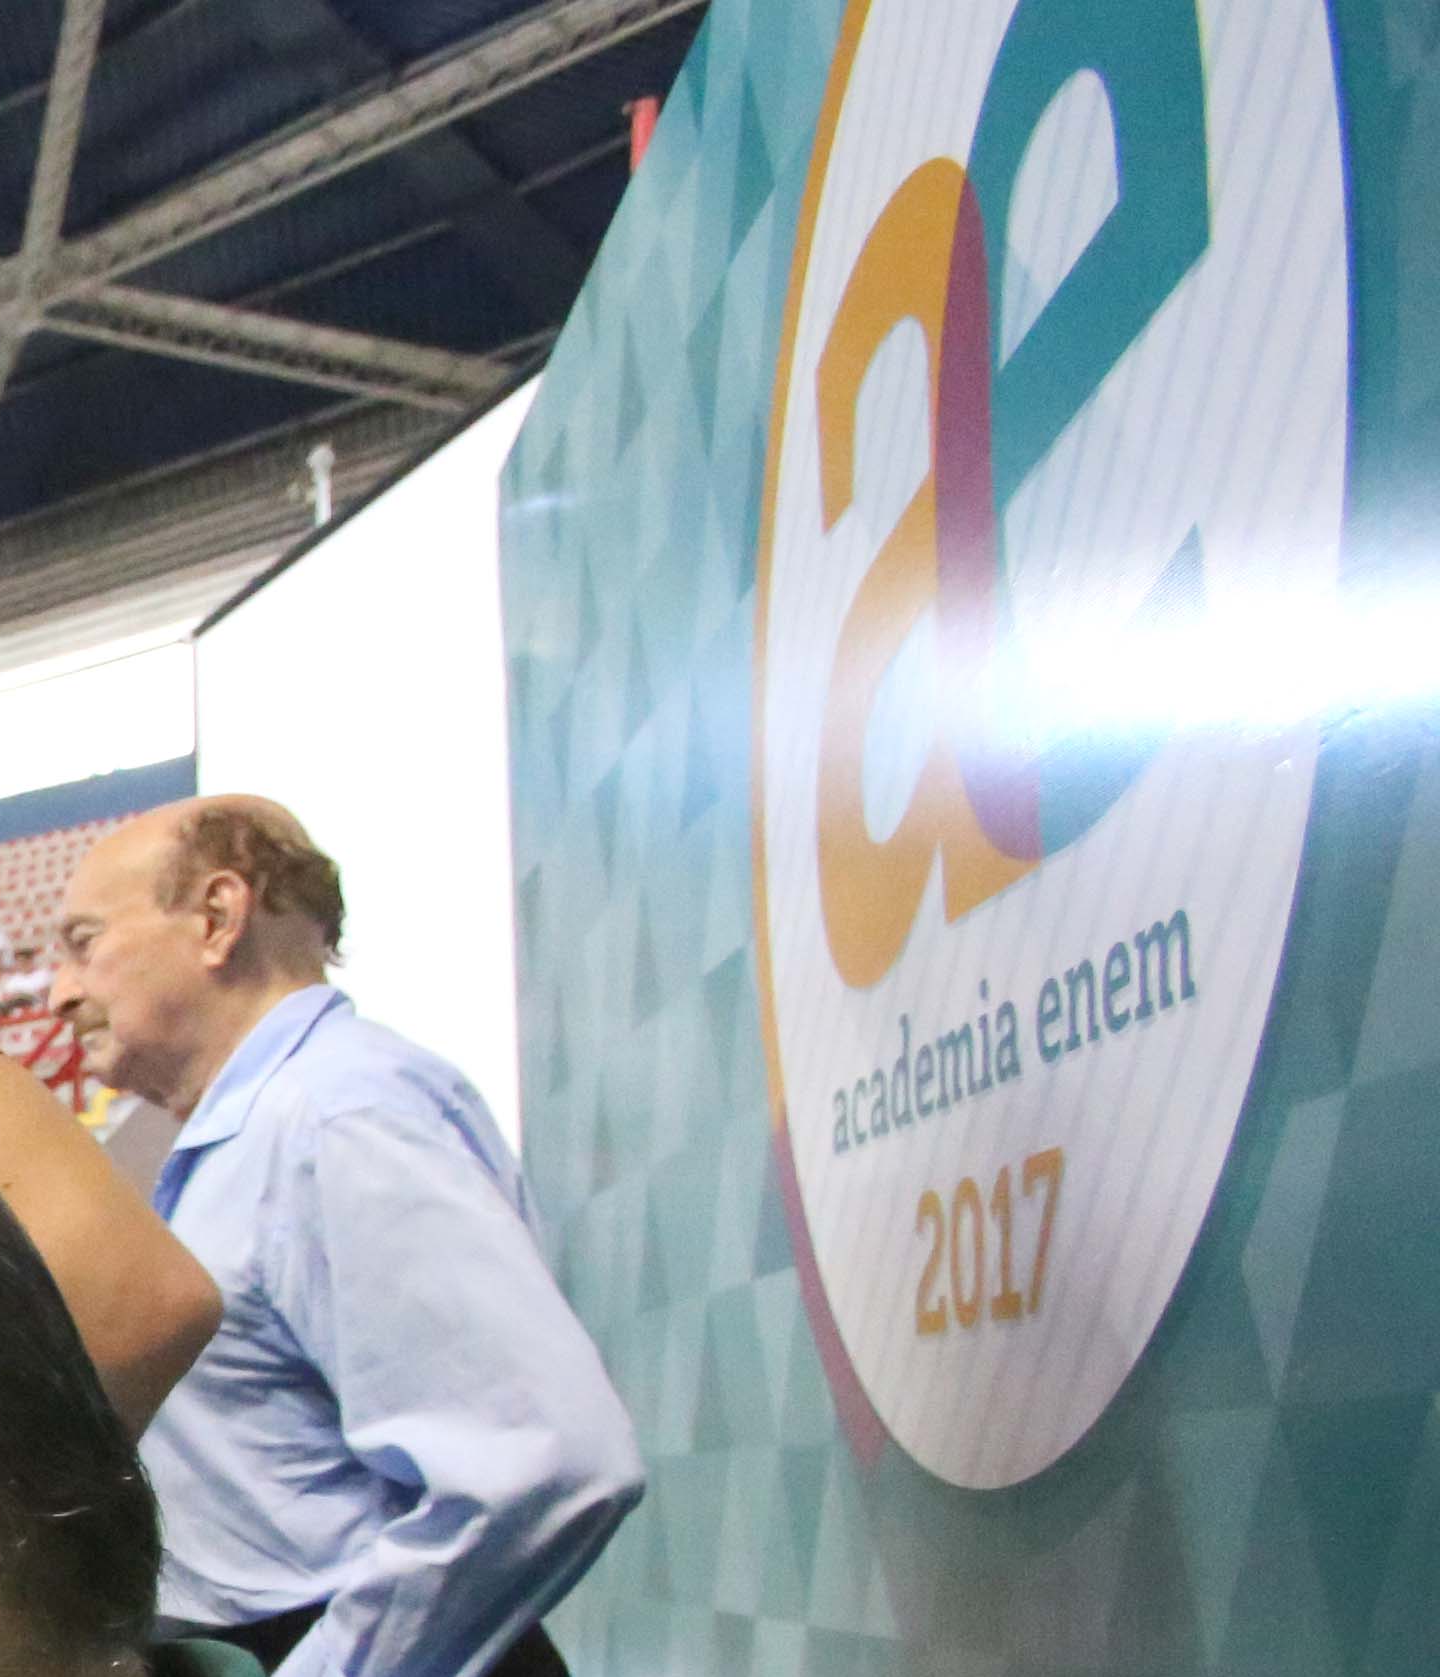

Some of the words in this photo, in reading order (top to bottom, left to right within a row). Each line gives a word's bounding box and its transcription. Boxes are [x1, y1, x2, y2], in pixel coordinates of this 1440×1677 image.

[833, 978, 1022, 1154] academia
[1036, 909, 1196, 1064] enem
[915, 1146, 1064, 1336] 2017
